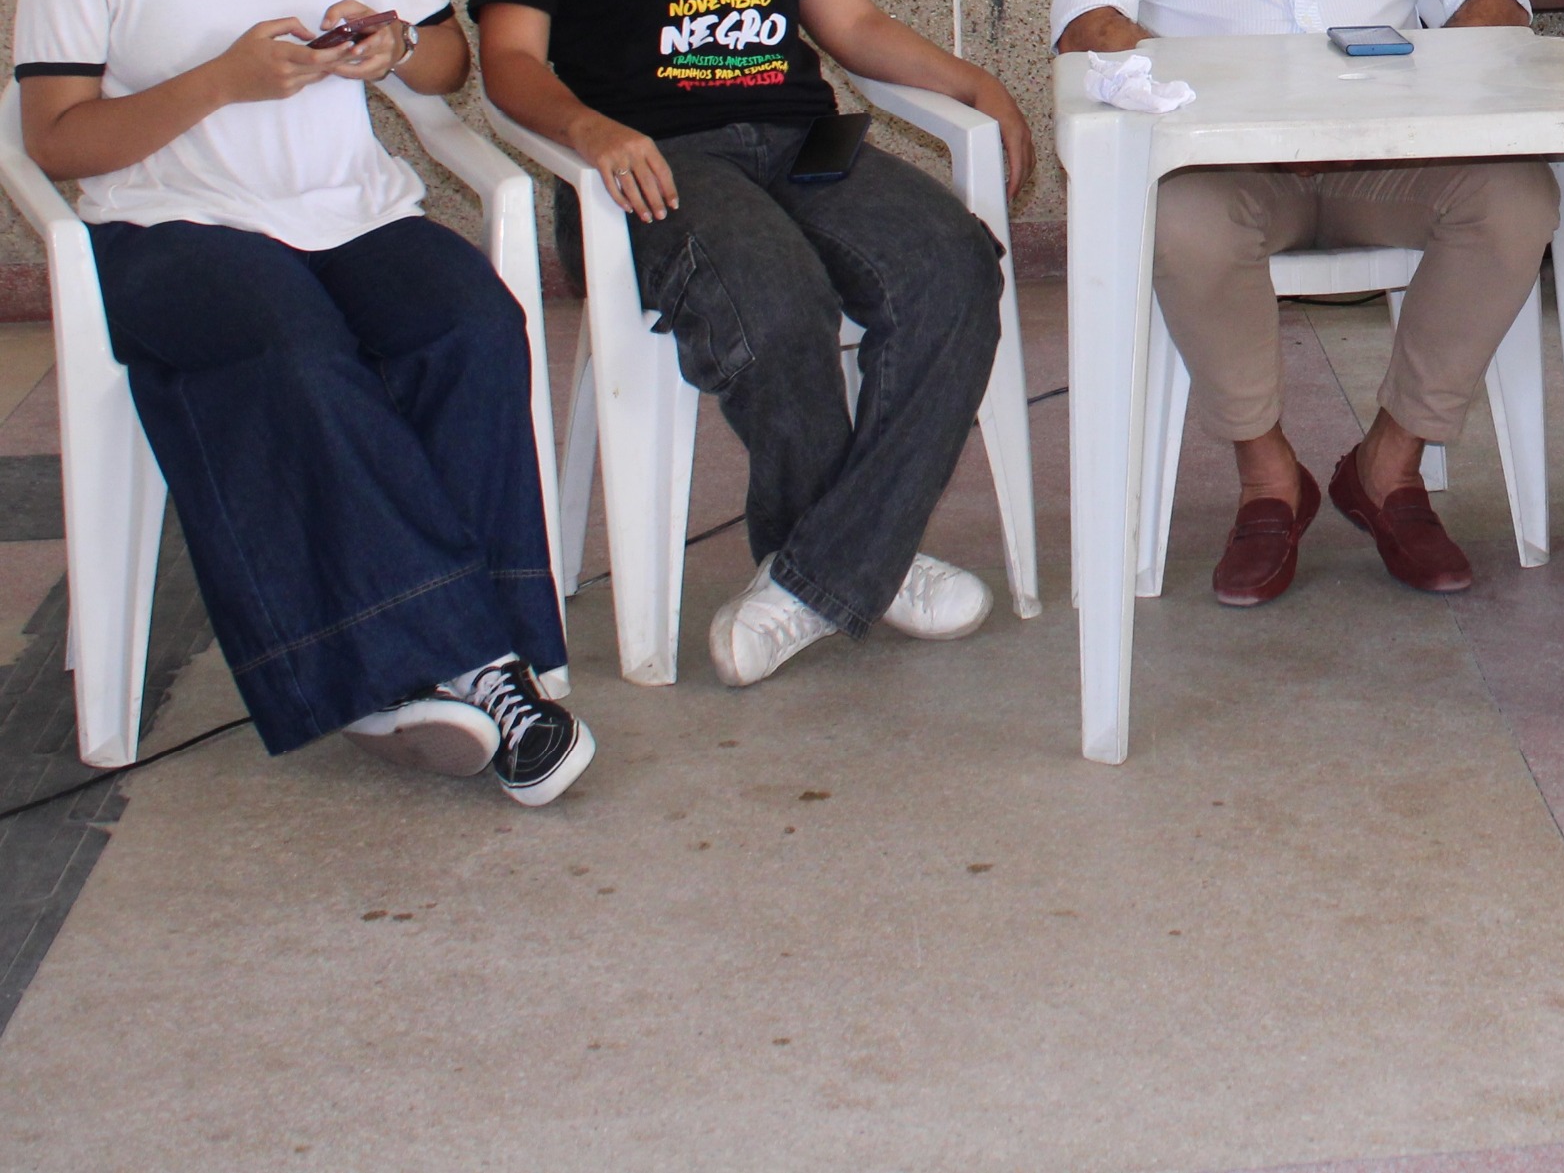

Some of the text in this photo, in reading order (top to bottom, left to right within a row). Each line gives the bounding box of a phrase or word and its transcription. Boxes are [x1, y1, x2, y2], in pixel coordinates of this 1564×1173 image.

[660, 8, 787, 56] NEGRO
[657, 66, 712, 80] CAMINHOS
[714, 68, 742, 80] PARA
